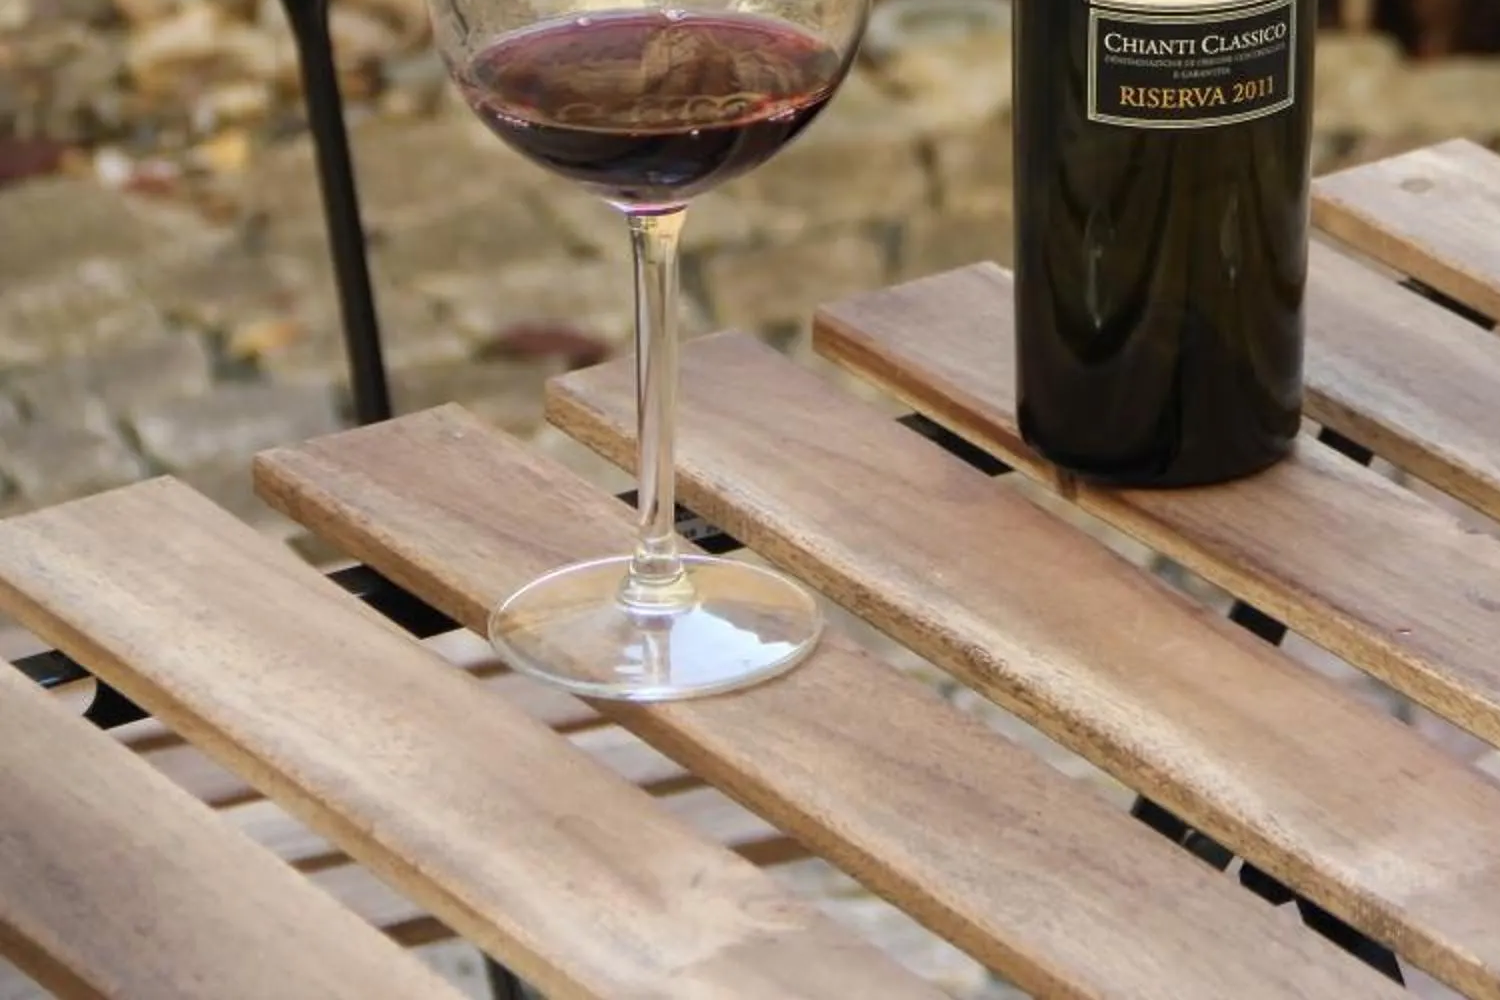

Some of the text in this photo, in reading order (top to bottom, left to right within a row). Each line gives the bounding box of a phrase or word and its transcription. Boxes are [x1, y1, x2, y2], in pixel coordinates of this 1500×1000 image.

[1104, 32, 1195, 55] CHIANTI
[1201, 23, 1287, 55] CLASSICO
[1119, 75, 1274, 109] RISERVA 2011
